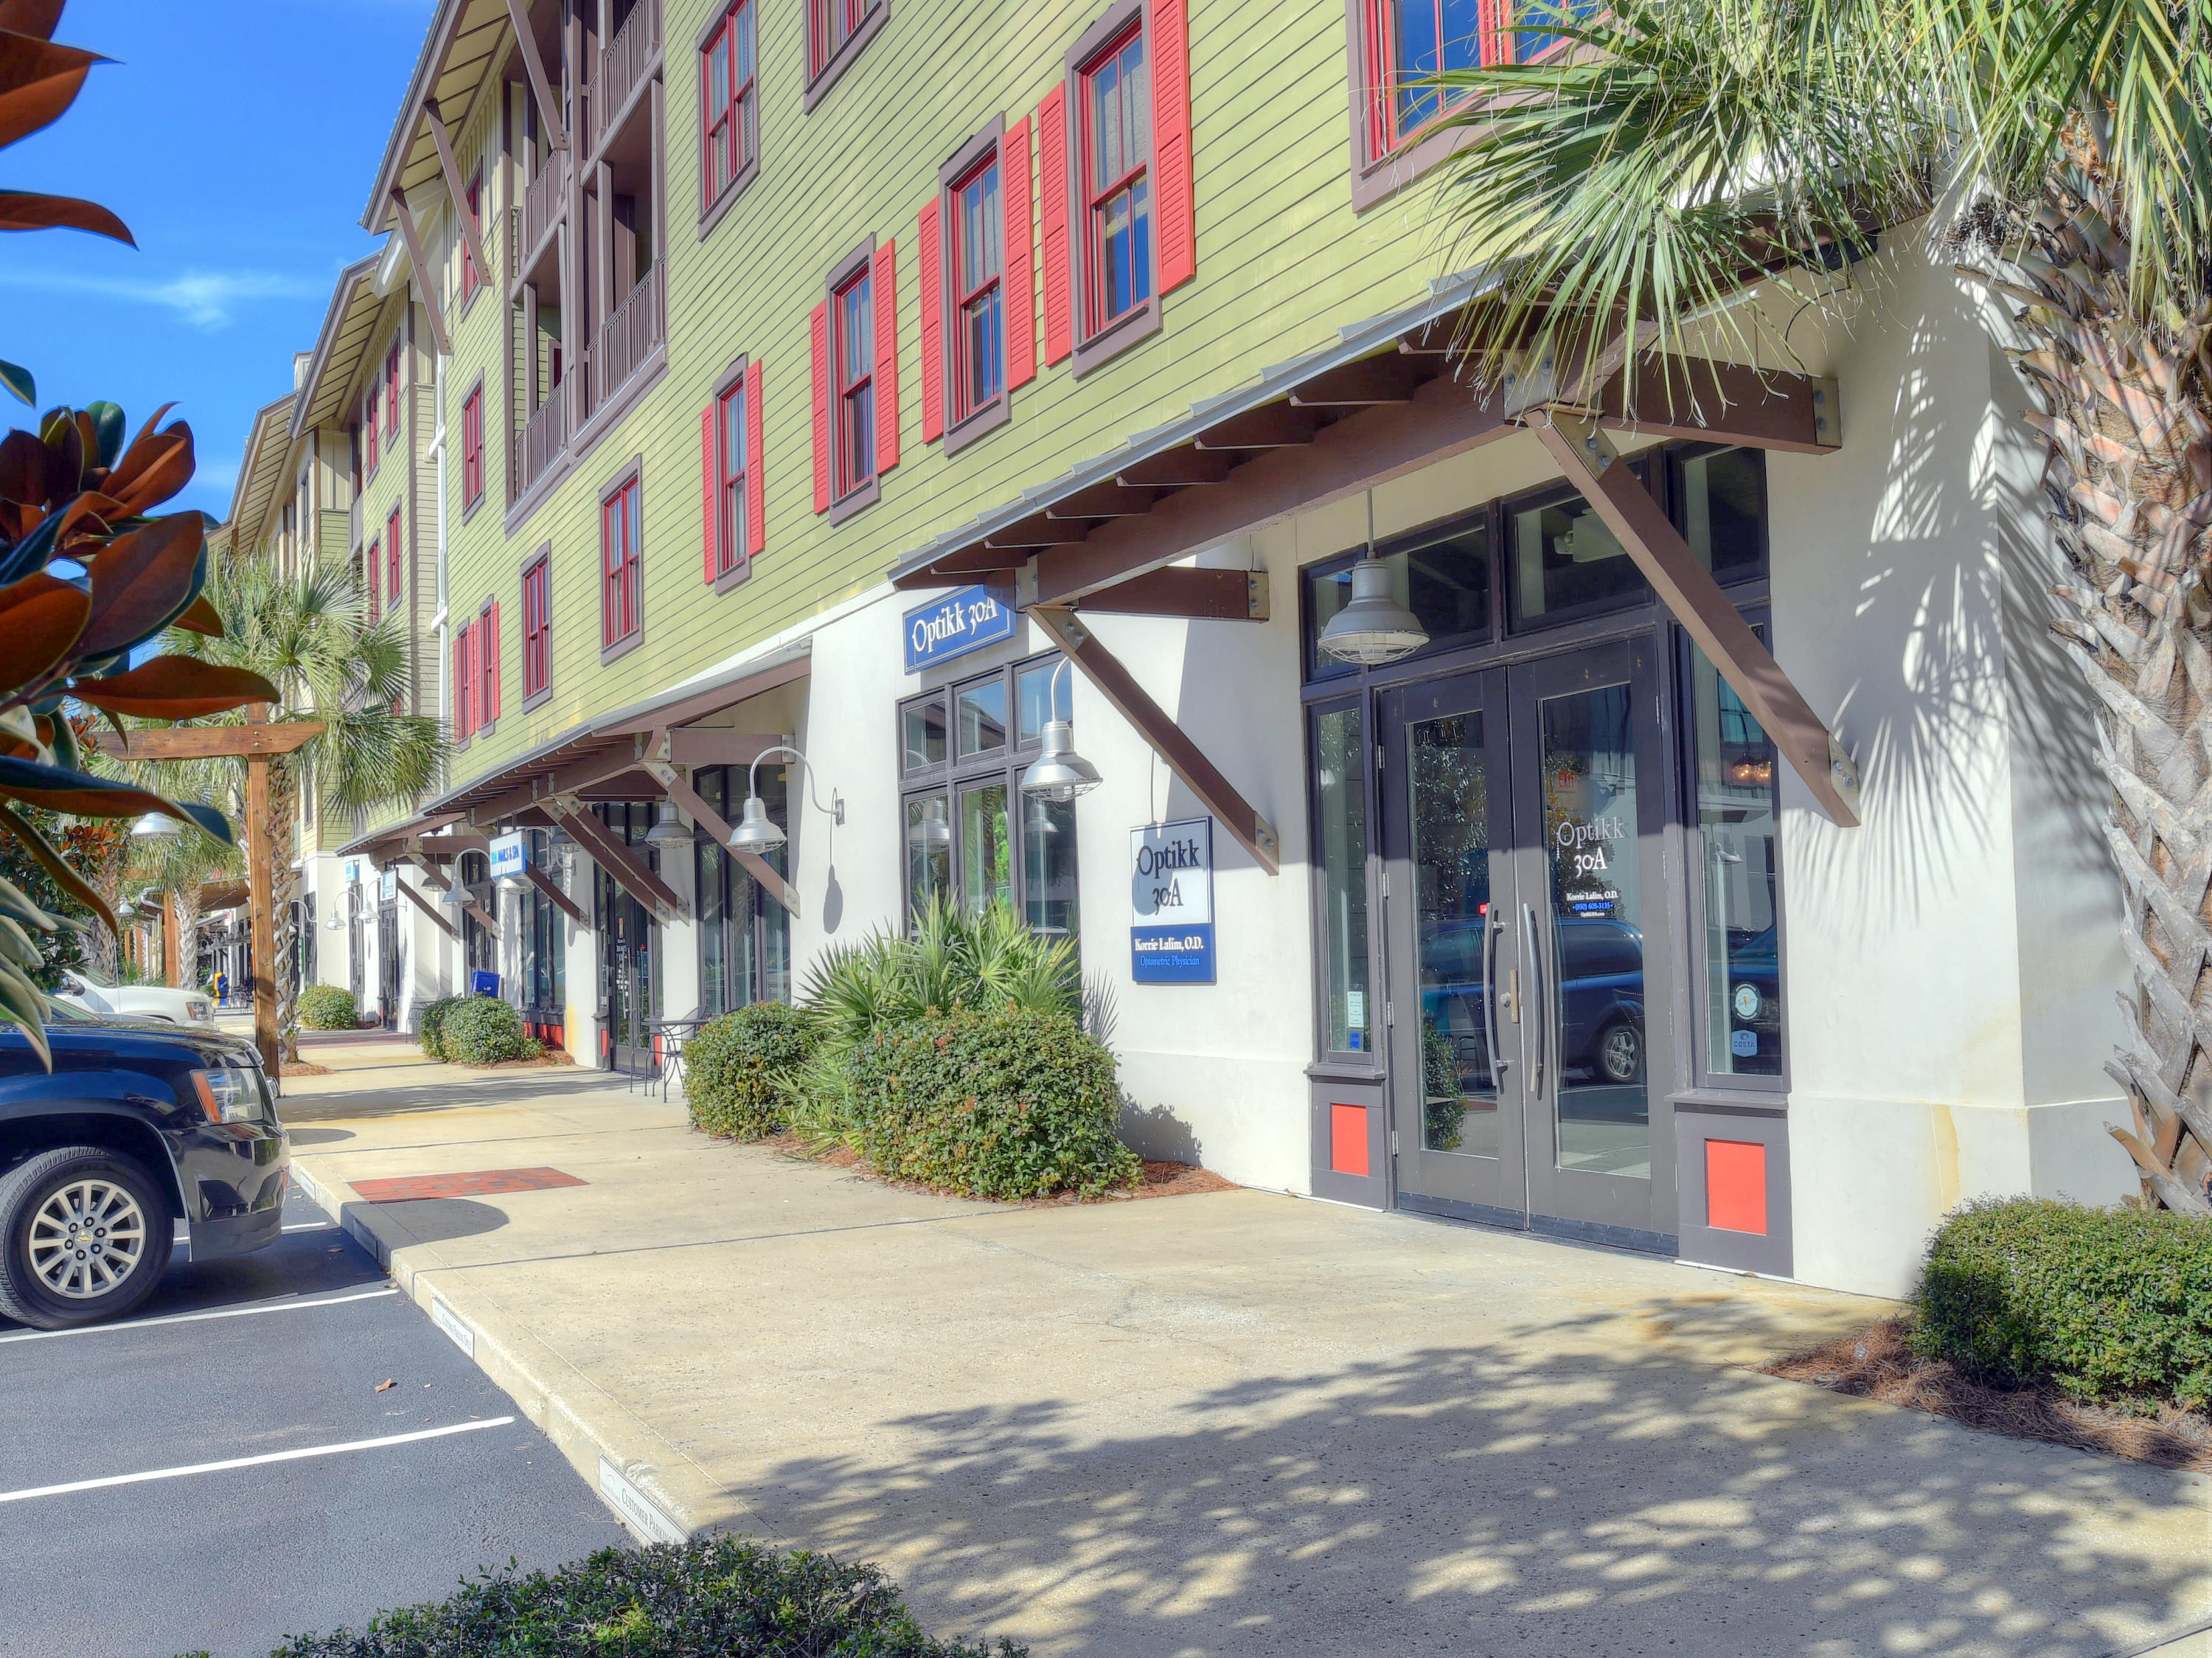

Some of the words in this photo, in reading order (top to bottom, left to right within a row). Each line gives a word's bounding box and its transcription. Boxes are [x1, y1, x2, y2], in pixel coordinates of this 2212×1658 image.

[912, 602, 967, 653] Optikk
[968, 597, 999, 636] 30A
[1557, 816, 1625, 849] Optikk
[1136, 839, 1200, 878] Optikk
[1574, 846, 1607, 878] 30A
[1152, 878, 1183, 915] 30A
[1566, 892, 1585, 901] Korrie
[1585, 891, 1604, 901] Lalim,
[1604, 890, 1618, 899] O.D.
[1135, 938, 1158, 951] Korrie
[1159, 937, 1184, 952] Lalim,
[1185, 936, 1204, 950] O.D.
[1140, 955, 1171, 968] Optometric
[1172, 954, 1200, 968] Physician
